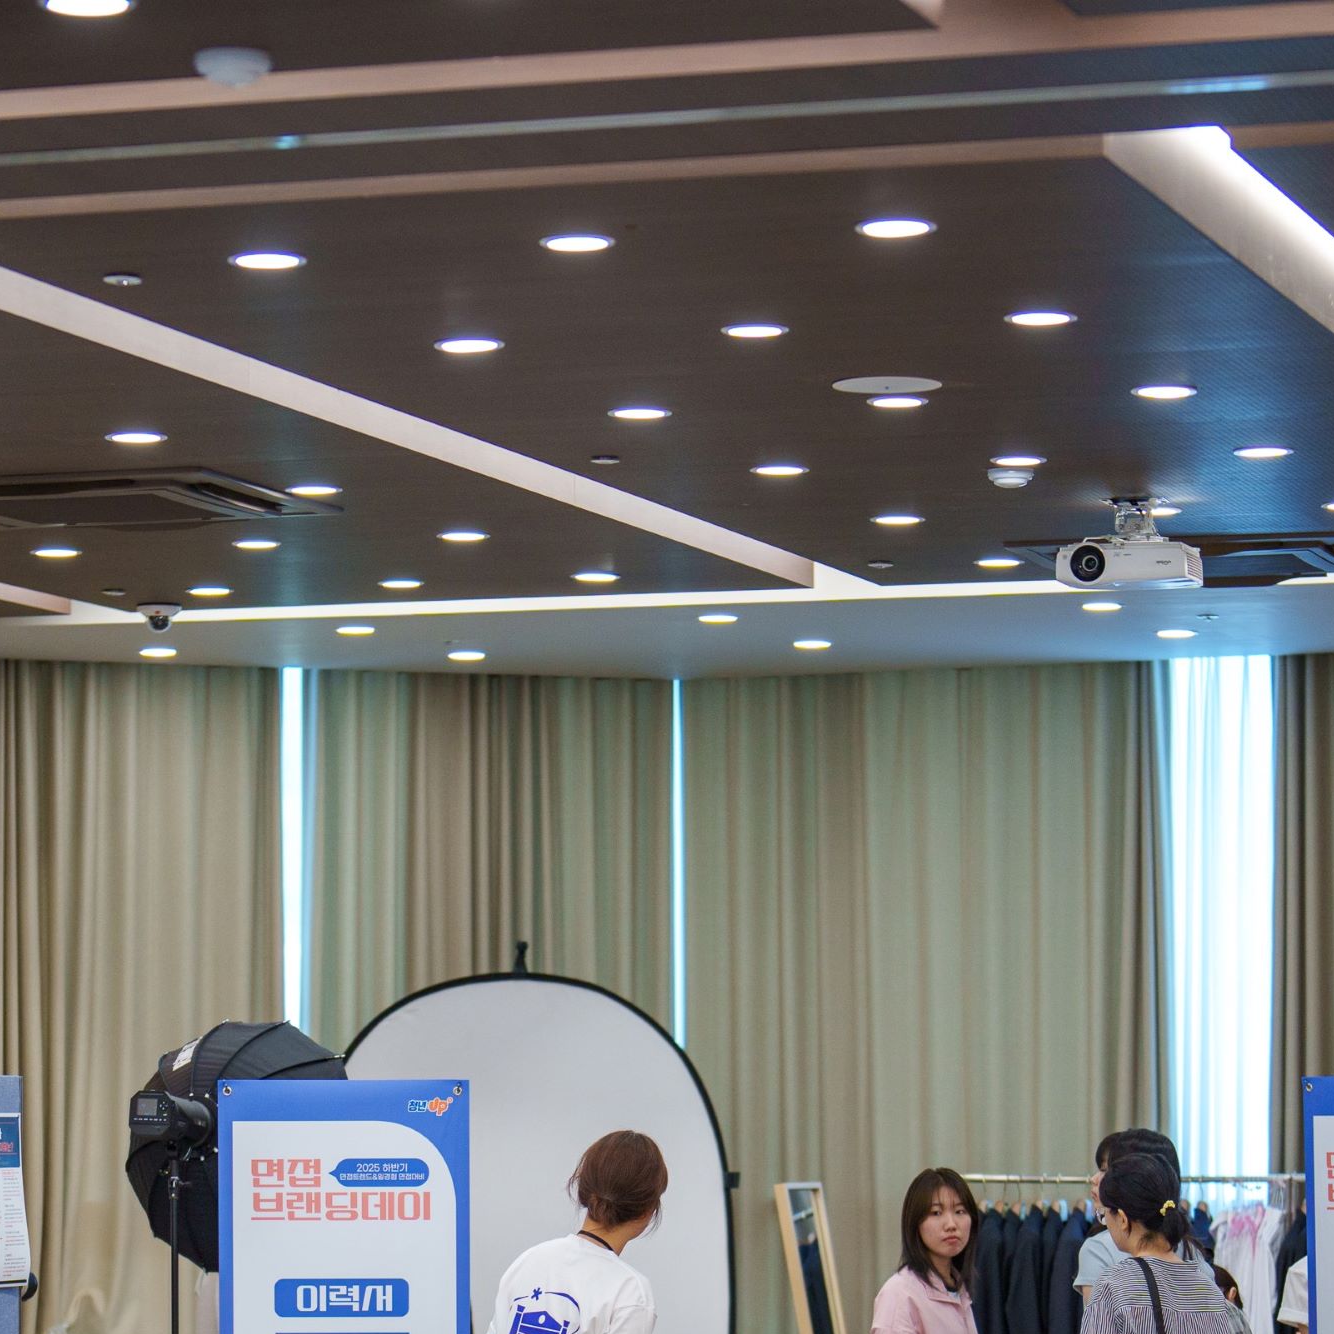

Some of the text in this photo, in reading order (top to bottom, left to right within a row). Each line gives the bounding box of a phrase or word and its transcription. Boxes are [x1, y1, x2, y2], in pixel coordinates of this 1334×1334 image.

[250, 1158, 408, 1189] 면접 2025 하반기
[250, 1190, 432, 1222] 브랜딩데이
[295, 1284, 394, 1313] 이력서
